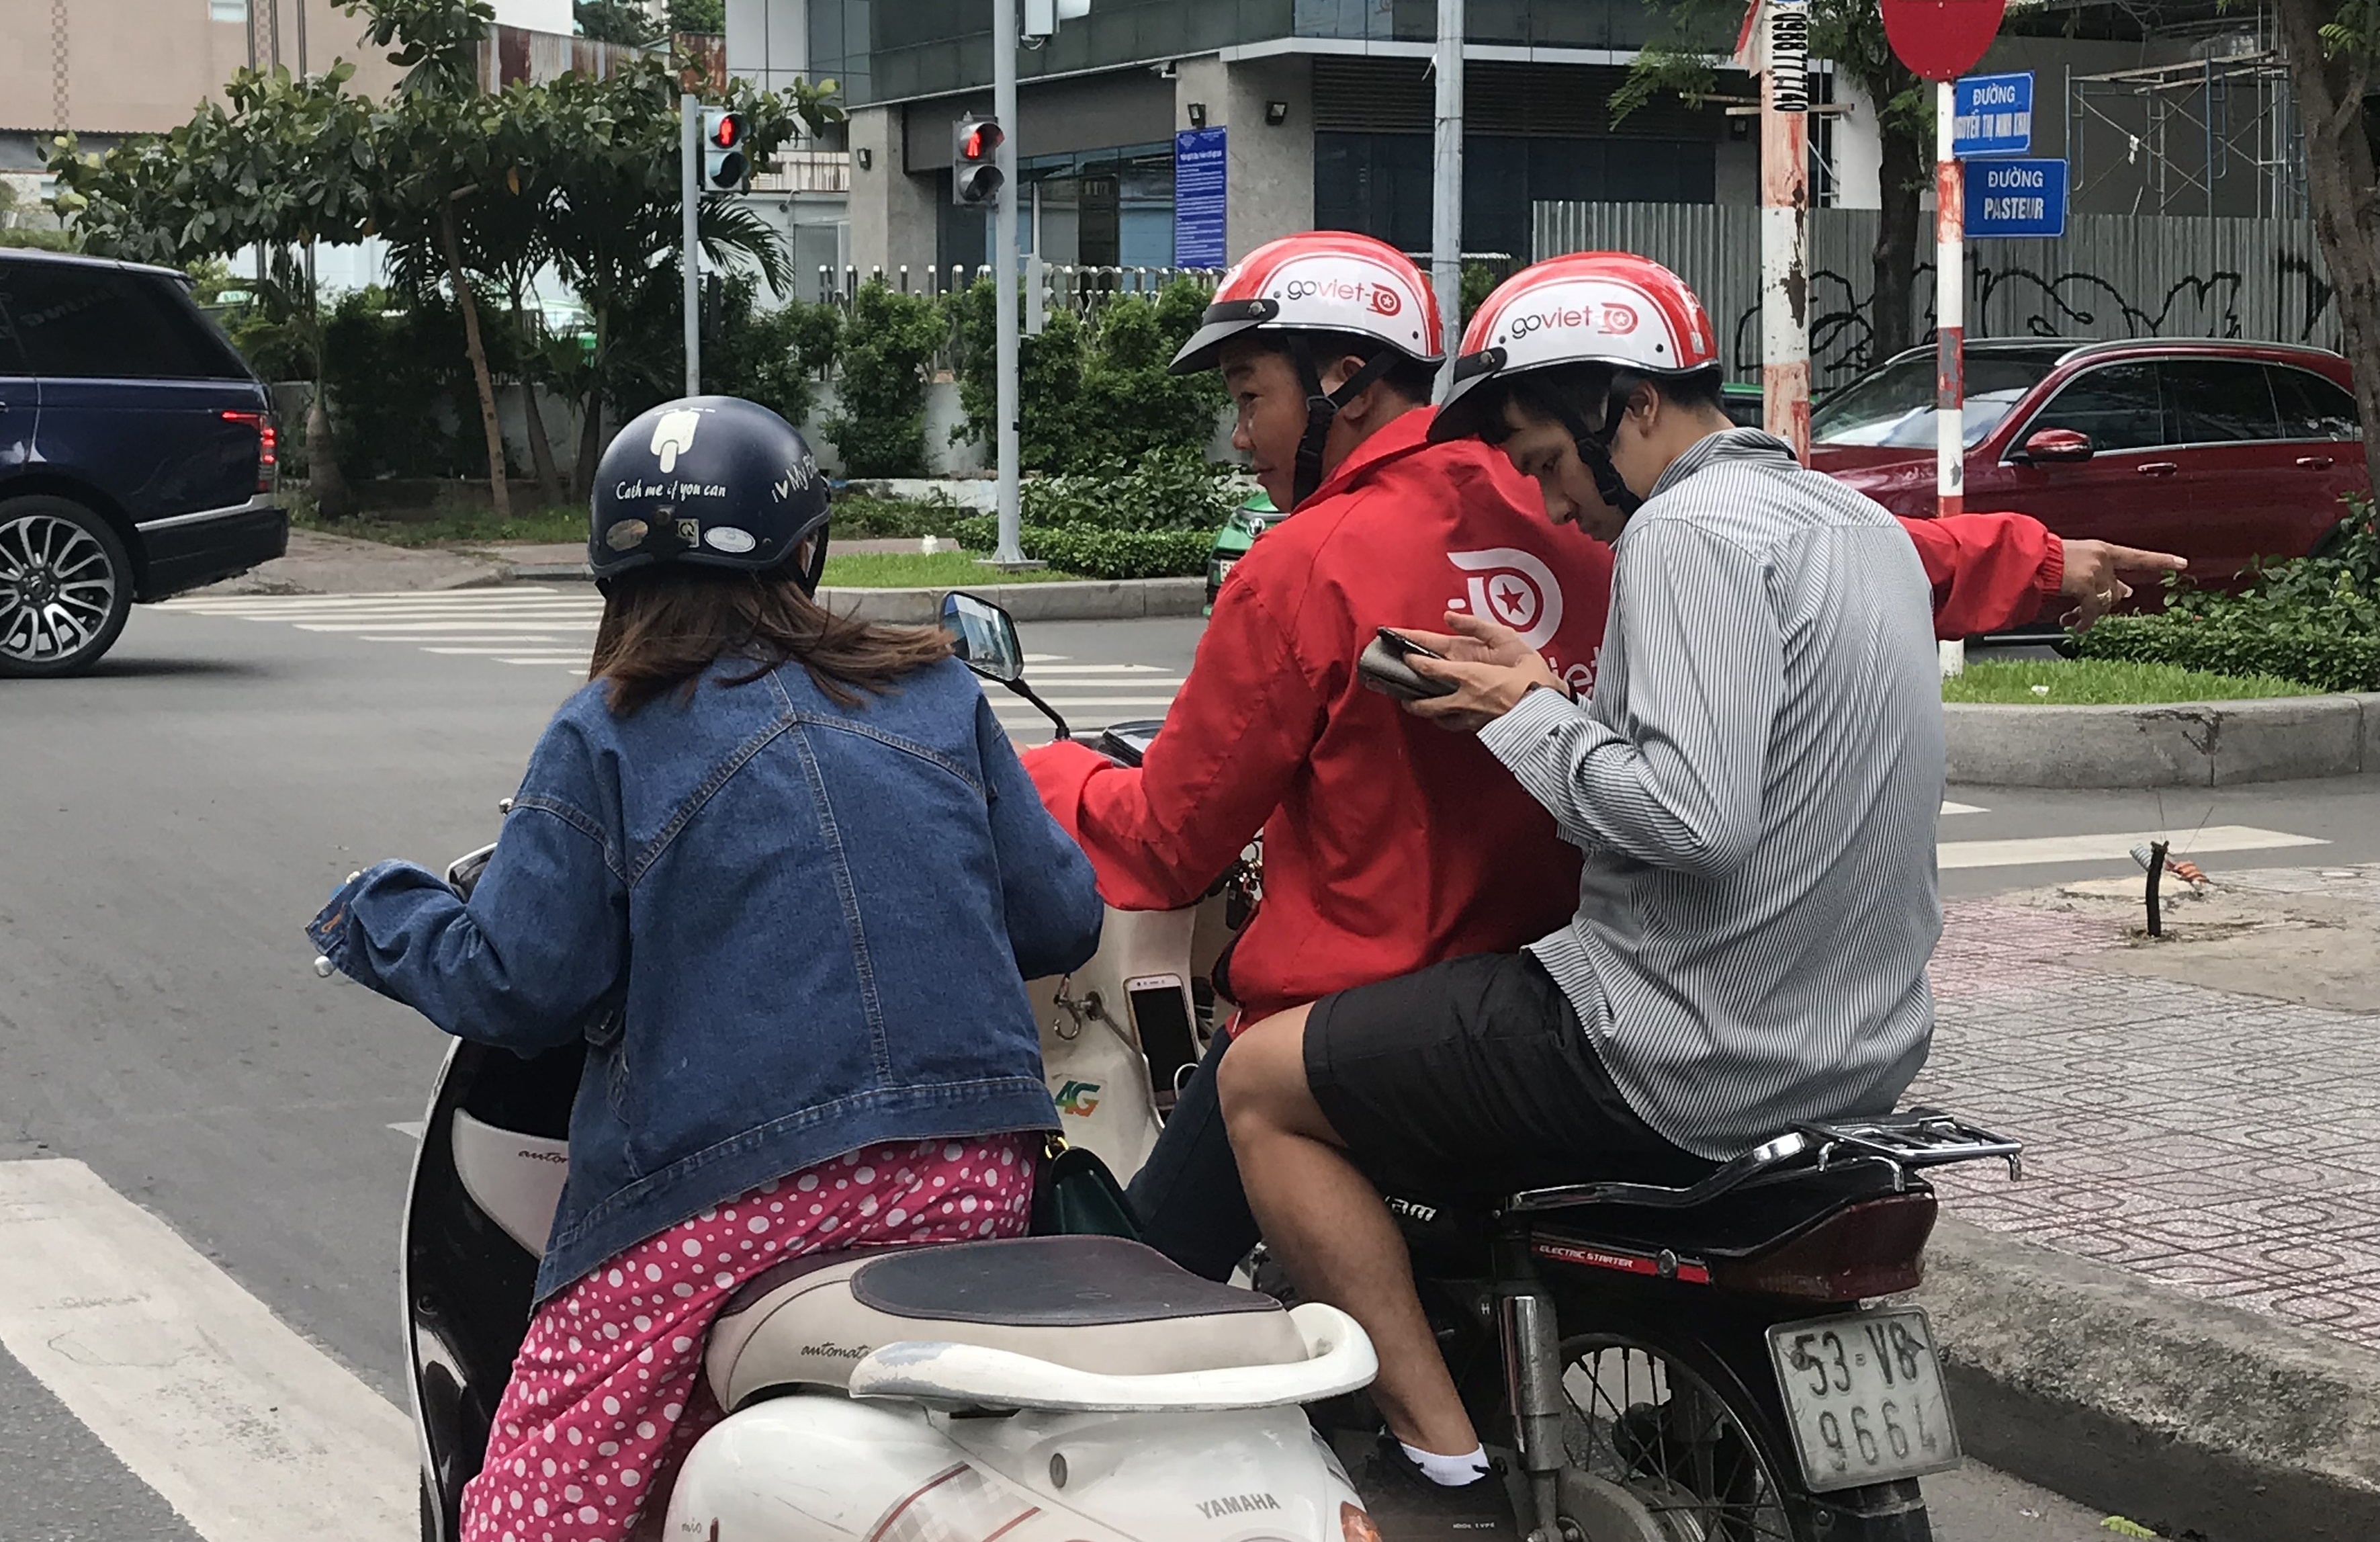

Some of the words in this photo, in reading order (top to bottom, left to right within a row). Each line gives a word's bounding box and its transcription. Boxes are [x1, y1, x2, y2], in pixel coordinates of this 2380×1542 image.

[1972, 83, 2016, 105] ĐƯỜNG
[1988, 167, 2044, 188] ĐƯỜNG
[1984, 197, 2044, 220] PASTEUR
[644, 484, 664, 497] me
[666, 480, 678, 501] if
[680, 482, 701, 502] you
[703, 484, 726, 498] can
[1539, 1244, 1586, 1260] ELECTRIC
[1586, 1252, 1634, 1268] STARTER
[1195, 1493, 1282, 1520] YAMAHA
